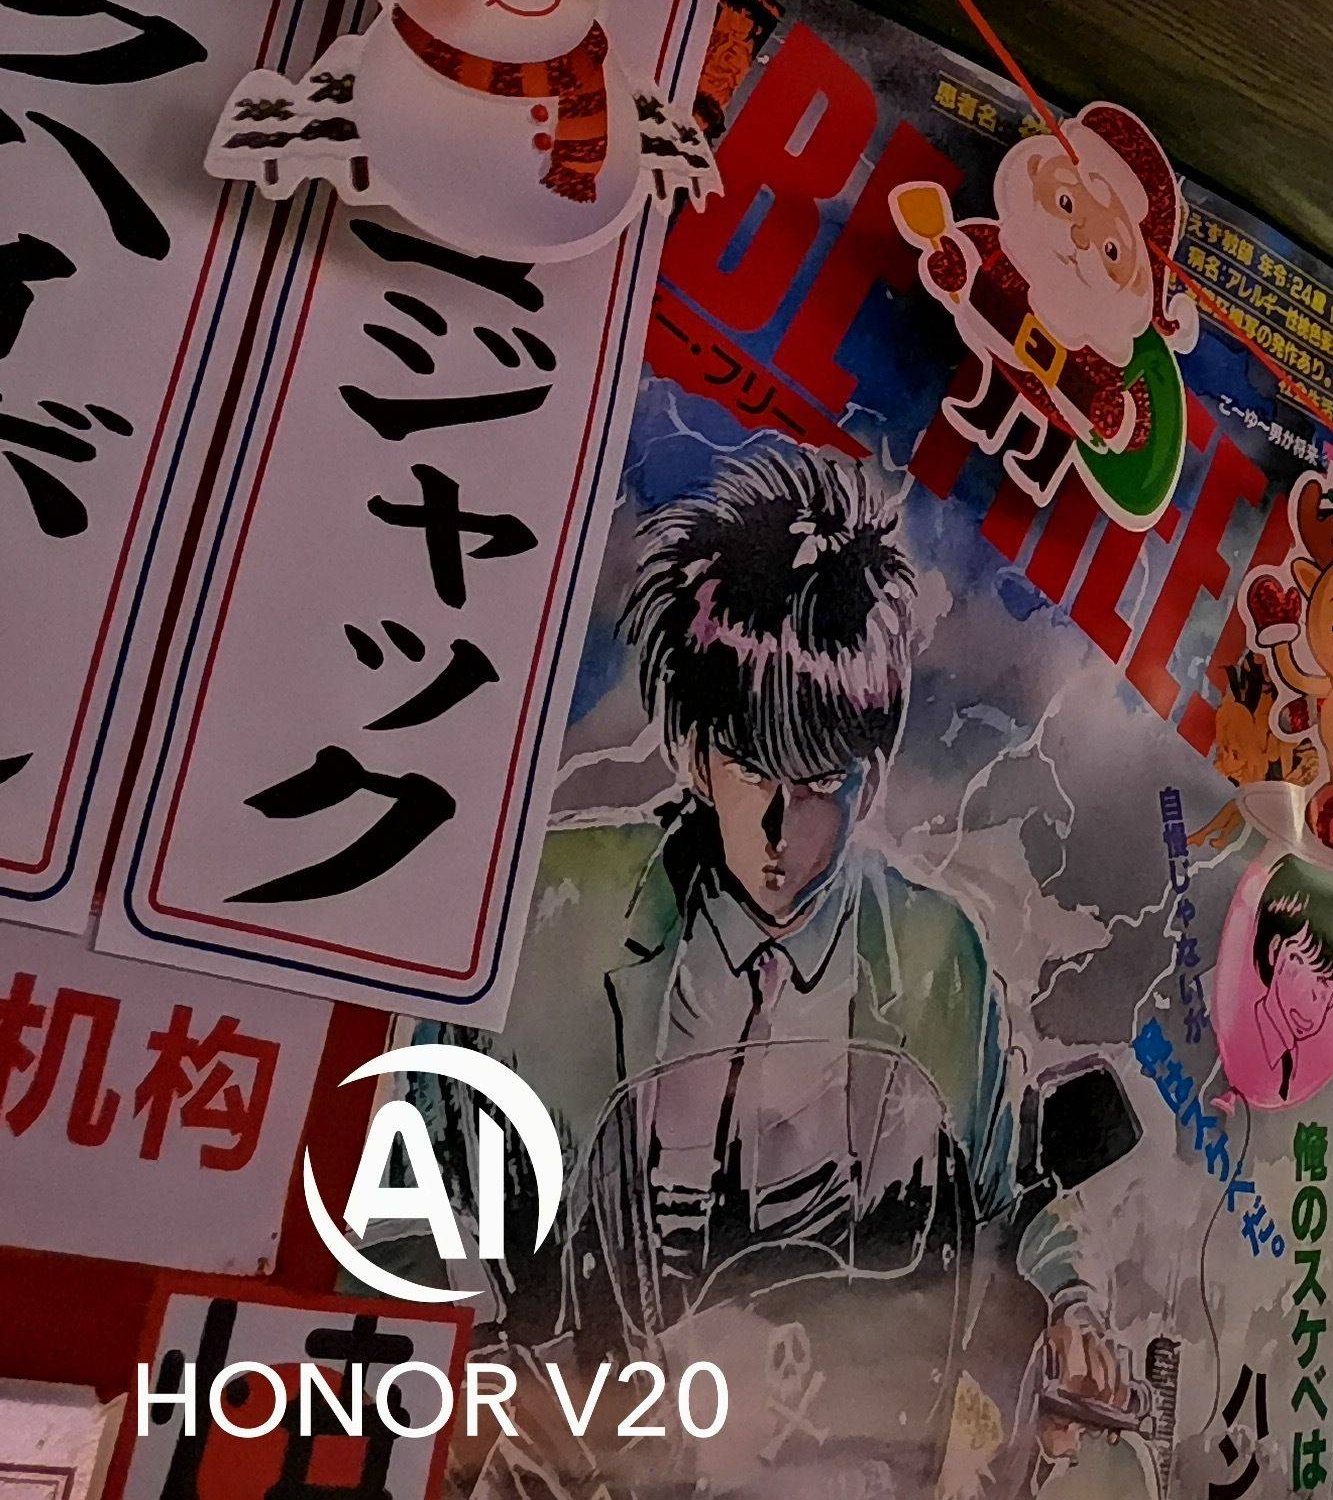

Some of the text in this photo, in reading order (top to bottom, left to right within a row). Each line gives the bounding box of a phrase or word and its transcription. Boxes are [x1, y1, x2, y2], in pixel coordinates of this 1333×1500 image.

[655, 311, 807, 438] ー・フリー
